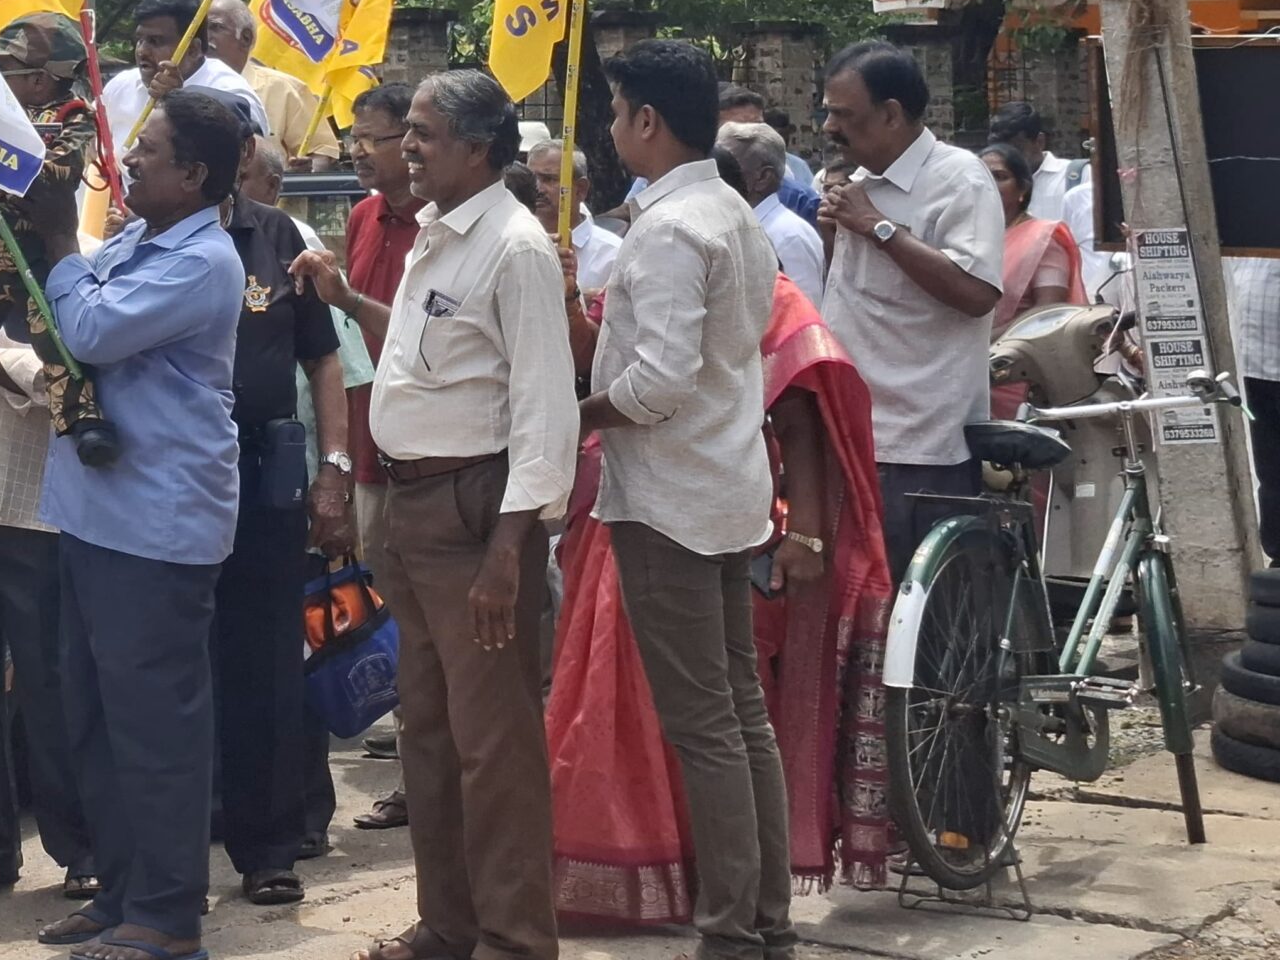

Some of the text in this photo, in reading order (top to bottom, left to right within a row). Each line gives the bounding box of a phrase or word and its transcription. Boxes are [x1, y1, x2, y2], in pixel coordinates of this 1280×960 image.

[1145, 233, 1179, 244] HOUSE
[1140, 245, 1187, 257] SHIFTING
[1143, 271, 1190, 284] Aishwarya
[1150, 283, 1186, 293] Packers
[1159, 342, 1193, 353] HOUSE
[1154, 354, 1202, 367] SHIFTING
[1159, 380, 1187, 389] Aishw
